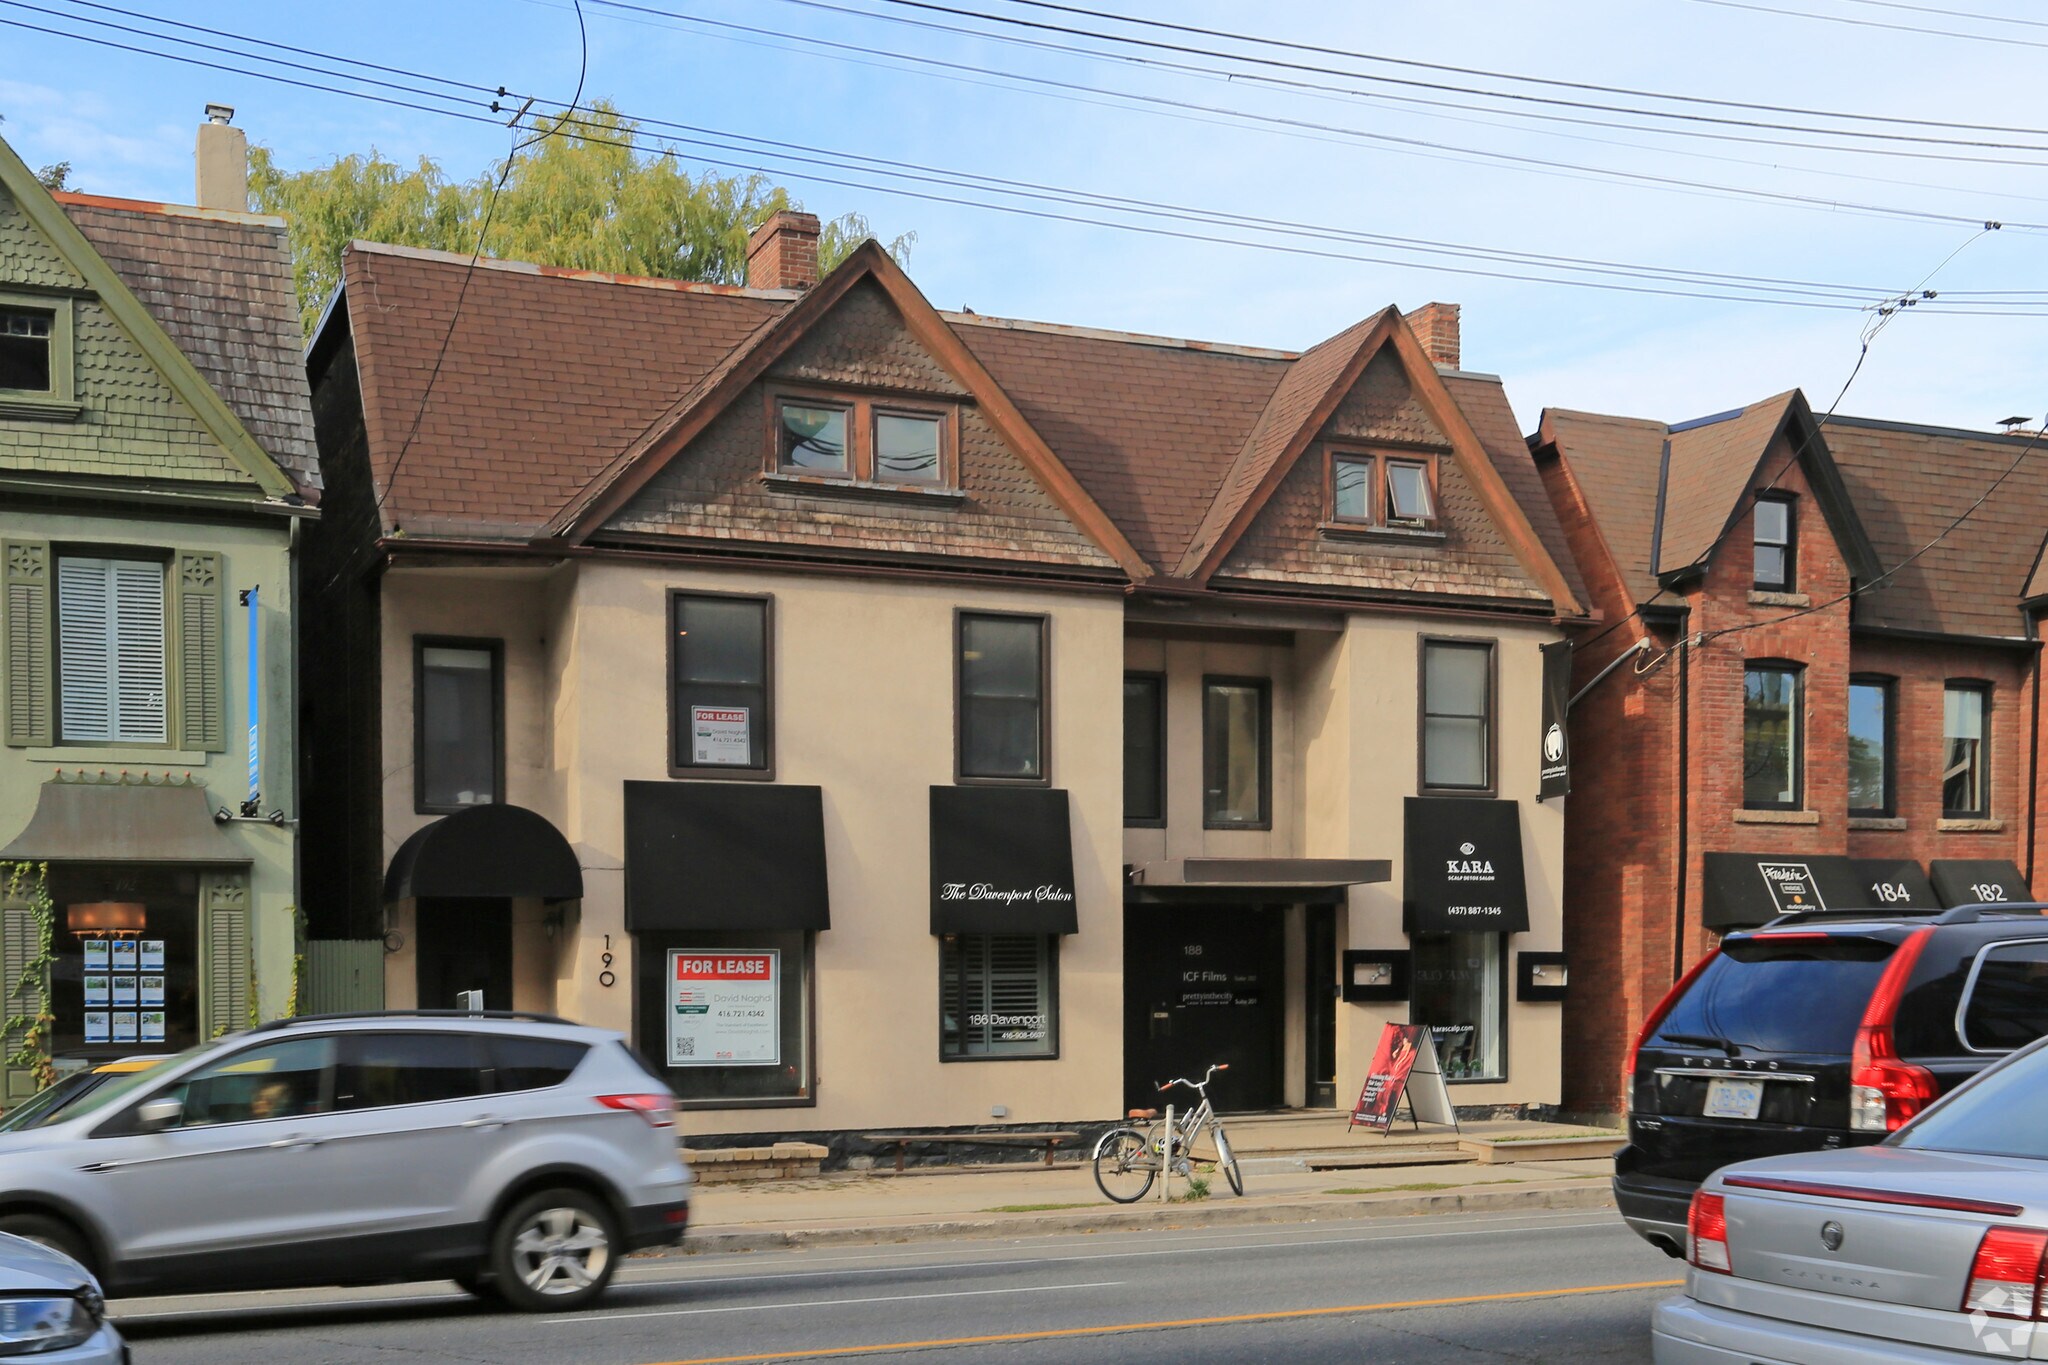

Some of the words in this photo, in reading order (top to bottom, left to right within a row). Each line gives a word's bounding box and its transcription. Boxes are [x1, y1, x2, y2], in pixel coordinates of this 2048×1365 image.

[696, 712, 714, 720] FOR
[716, 713, 745, 721] LEASE
[1446, 860, 1494, 874] KARA
[941, 882, 966, 900] The
[968, 882, 1033, 906] Davenport
[1034, 884, 1073, 903] Salon
[1871, 883, 1910, 902] 184
[1970, 884, 2008, 902] 182
[1447, 906, 1467, 915] (437)
[1467, 906, 1501, 915] 887-1345
[1183, 945, 1203, 956] 188
[599, 934, 615, 987] 190
[682, 959, 713, 974] FOR
[717, 959, 764, 974] LEASE
[1183, 971, 1199, 982] ICF
[1202, 971, 1227, 982] Films
[713, 993, 739, 1002] David
[740, 993, 772, 1003] Naghdi
[717, 1009, 765, 1017] 416.721.4342
[969, 1014, 989, 1026] 186
[990, 1014, 1046, 1027] Davenport
[1781, 1268, 1881, 1289] CATERA
